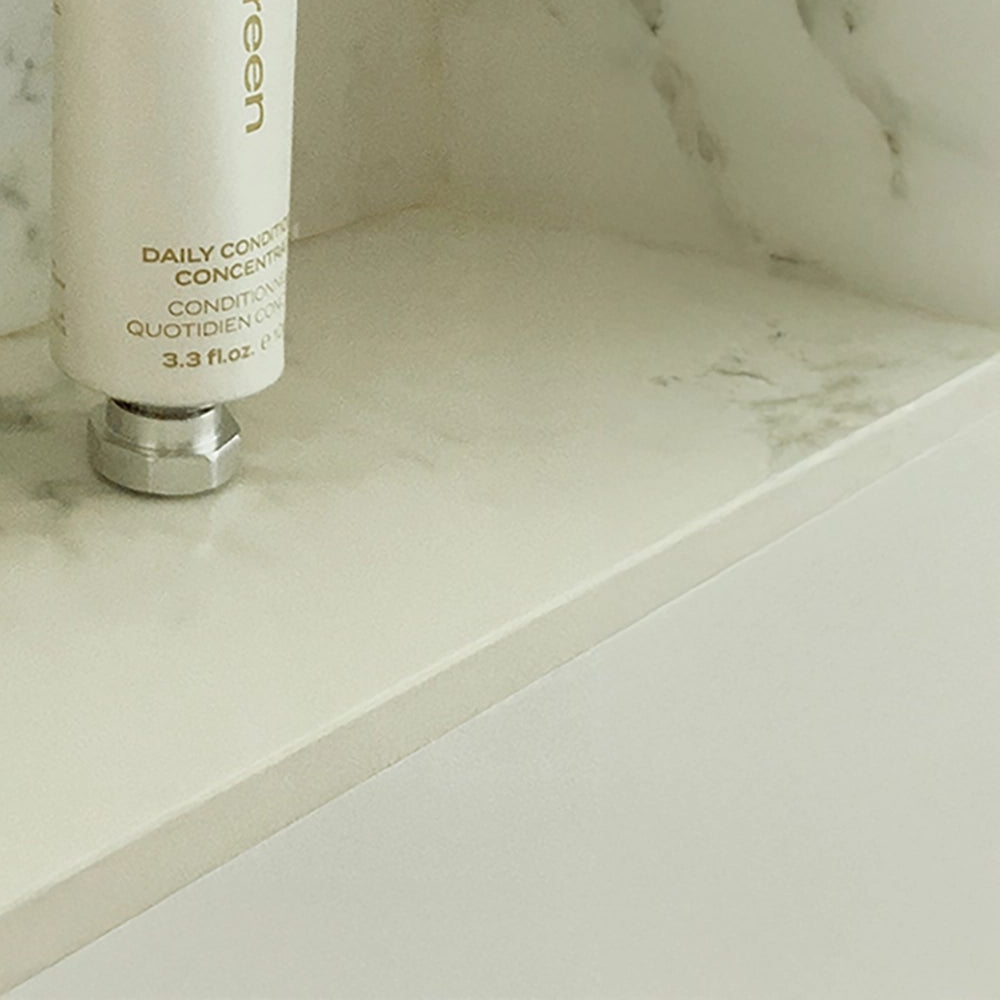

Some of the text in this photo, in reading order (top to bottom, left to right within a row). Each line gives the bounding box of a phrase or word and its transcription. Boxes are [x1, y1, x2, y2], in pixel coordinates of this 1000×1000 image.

[142, 246, 215, 264] DAILY
[126, 313, 251, 339] QUOTIDIEN
[162, 352, 201, 368] 3.3
[207, 345, 255, 365] fl.oz.
